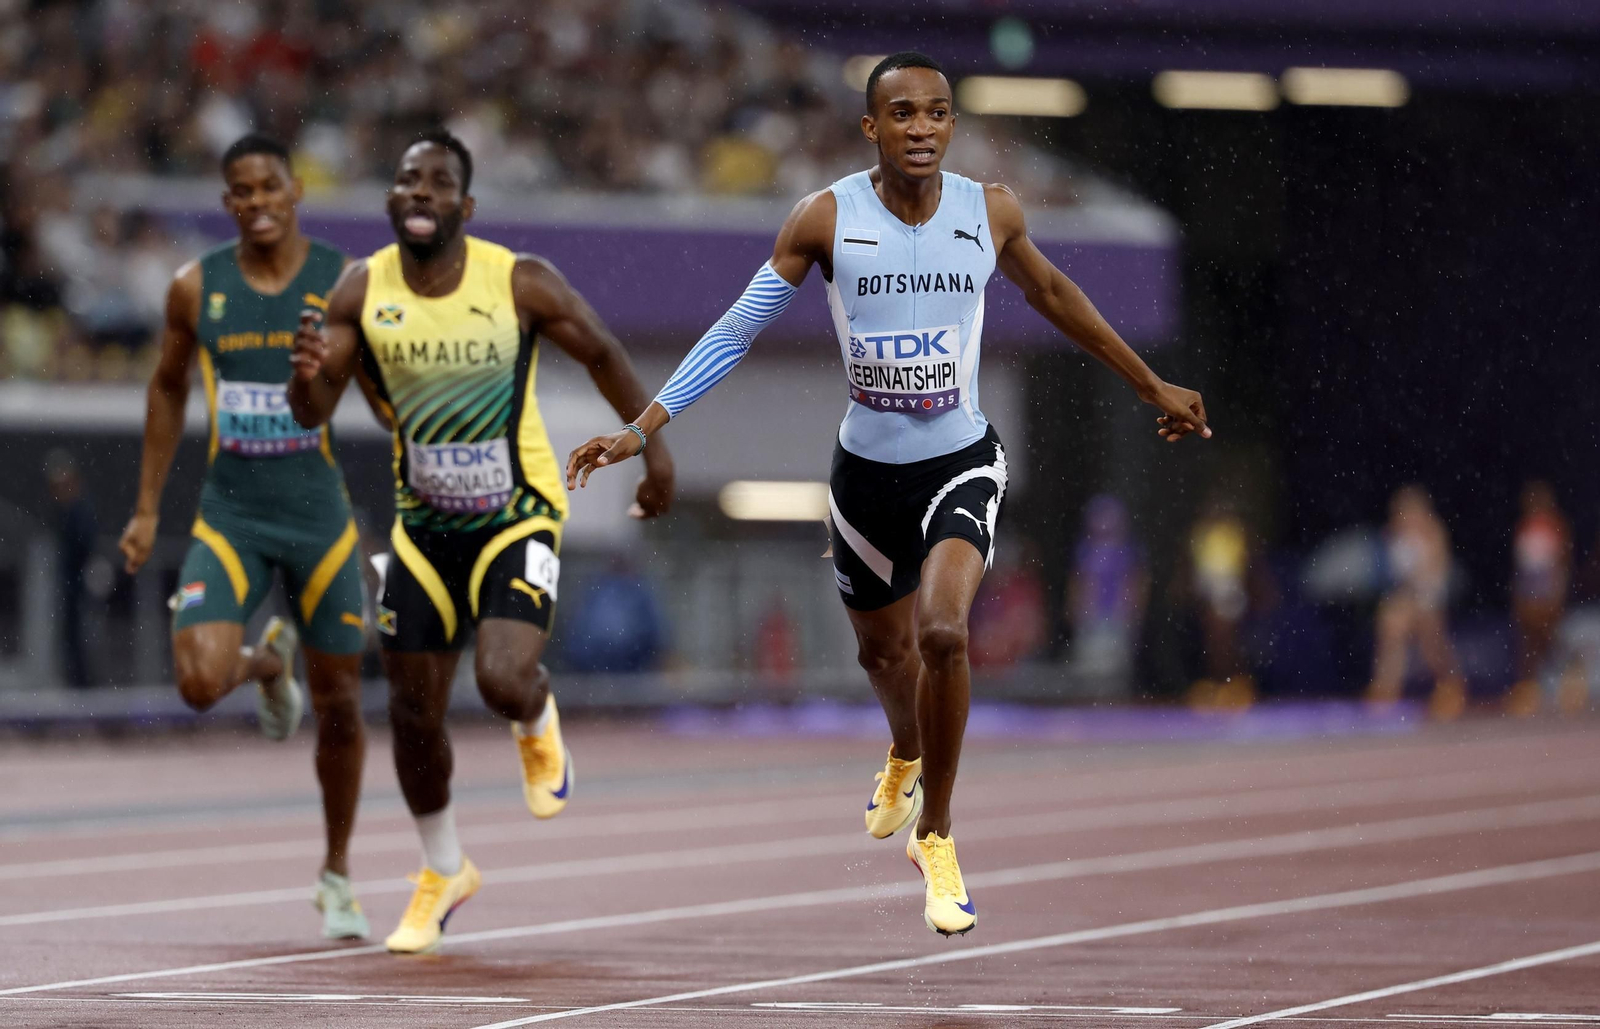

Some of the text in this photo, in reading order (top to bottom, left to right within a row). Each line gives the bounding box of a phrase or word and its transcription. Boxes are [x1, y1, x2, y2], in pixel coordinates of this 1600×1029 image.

[857, 273, 975, 297] BOTSWANA
[864, 330, 950, 360] TDK
[848, 361, 957, 391] KEBINATSHIPI
[244, 388, 289, 410] TD
[229, 413, 299, 435] NEN
[431, 445, 498, 468] TDK
